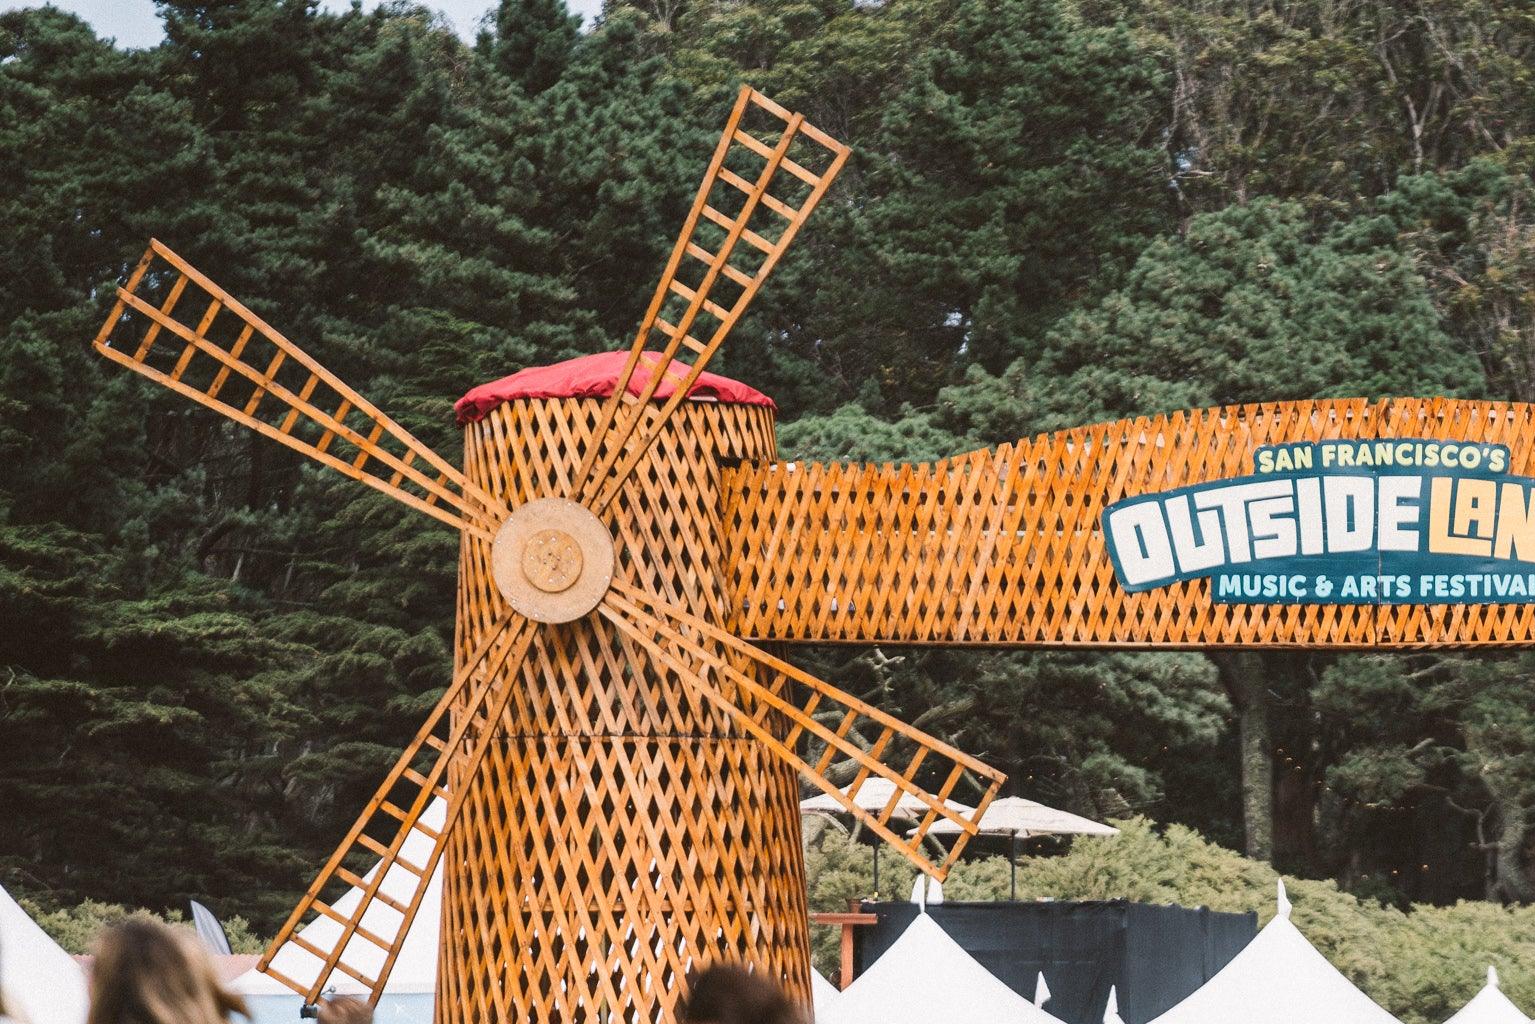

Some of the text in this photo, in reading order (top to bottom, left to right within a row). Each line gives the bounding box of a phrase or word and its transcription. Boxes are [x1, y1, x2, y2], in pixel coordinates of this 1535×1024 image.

[1259, 444, 1506, 473] SAN FRANCISCO'S
[1109, 475, 1420, 586] OUTSIDE
[1218, 574, 1311, 598] MUSIC
[1315, 575, 1334, 597] &
[1341, 574, 1411, 598] ARTS
